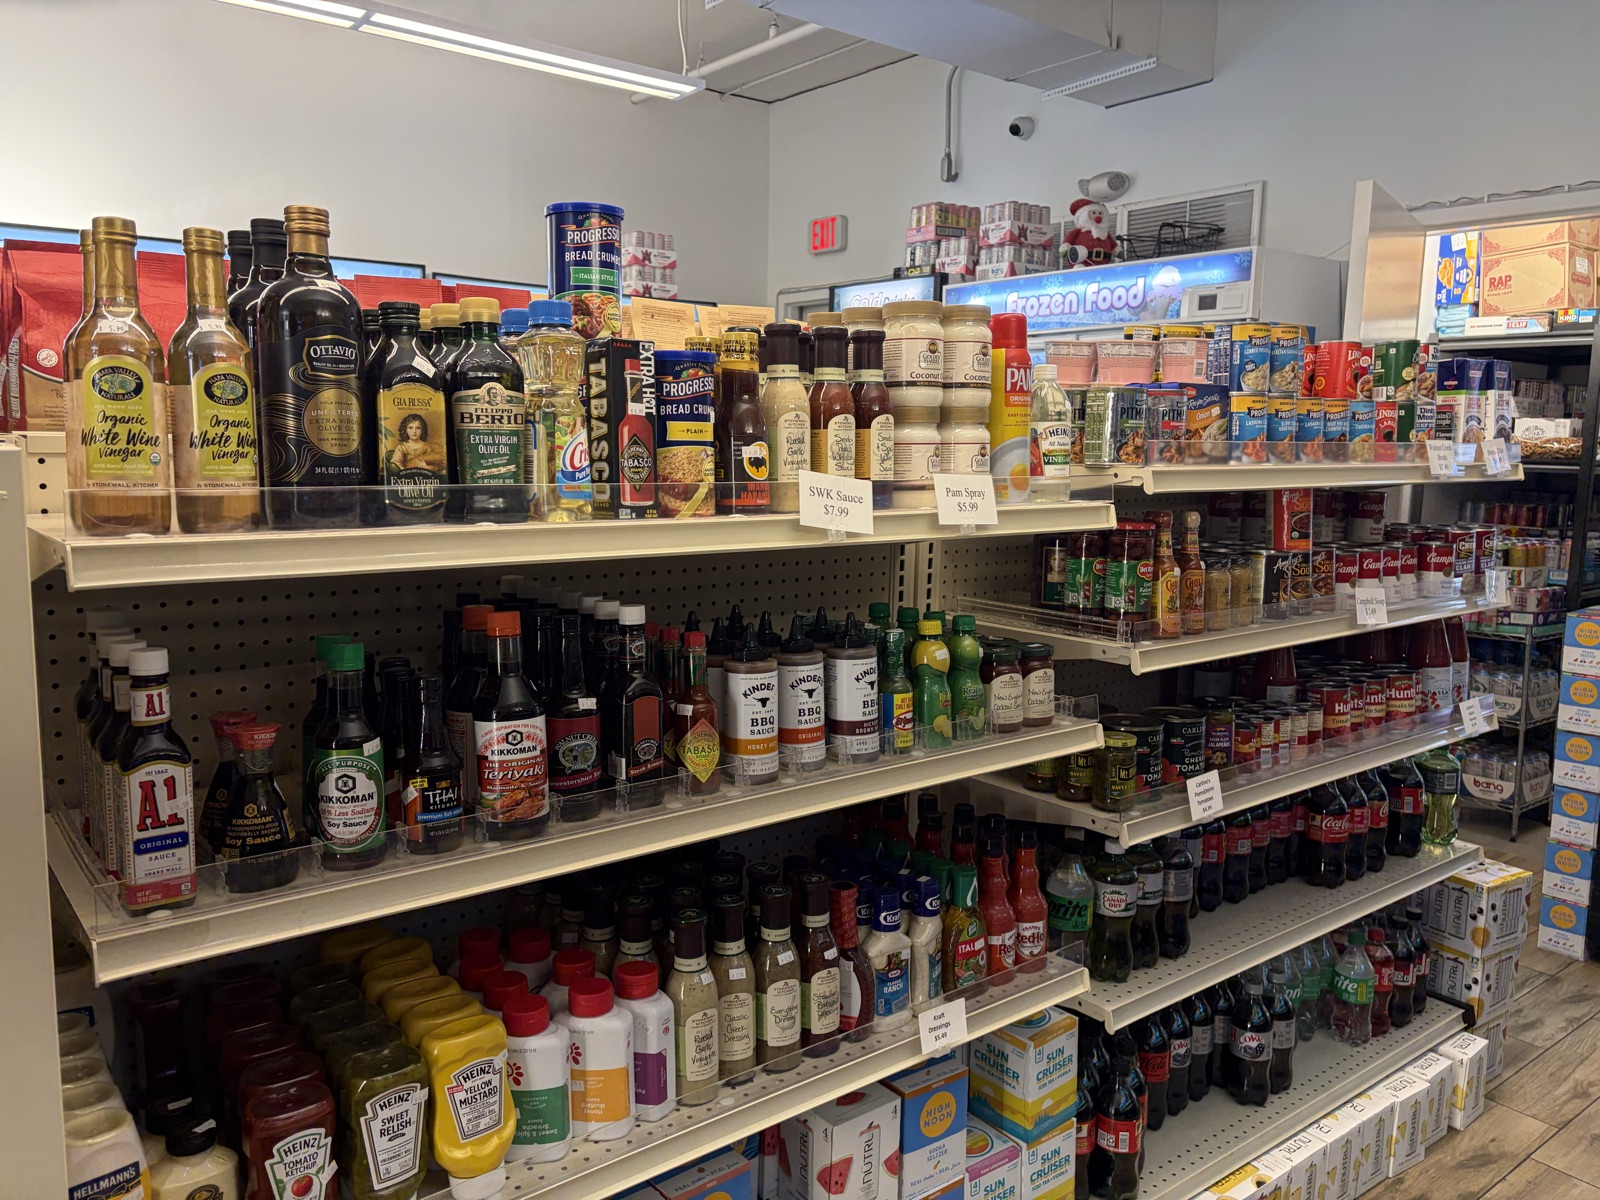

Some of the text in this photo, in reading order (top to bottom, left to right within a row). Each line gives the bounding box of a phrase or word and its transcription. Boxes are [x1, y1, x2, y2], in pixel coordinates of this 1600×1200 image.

[568, 228, 620, 243] PROGRESSO
[812, 218, 837, 250] EXIT
[565, 251, 593, 262] BREAD
[601, 274, 614, 282] STYLE
[1489, 274, 1512, 289] RAP
[1006, 276, 1146, 318] Frozen Food
[1560, 314, 1578, 322] KIND
[310, 345, 356, 360] OTTAVIO
[640, 342, 656, 416] EXTRA HOT
[910, 371, 938, 380] Coconut
[964, 373, 990, 382] Coconut
[662, 378, 714, 396] PROGRESSO
[100, 392, 136, 400] NATURALS
[393, 397, 430, 407] GIA RUSSA
[660, 404, 690, 416] BREAD
[1196, 412, 1210, 420] Onion
[97, 410, 148, 428] Organic
[210, 414, 251, 433] Organic
[309, 418, 336, 426] EXTRA
[460, 412, 524, 425] BERIO
[589, 357, 610, 500] TABASCO
[1049, 428, 1070, 438] HEINZ
[81, 427, 160, 448] White Wine
[190, 430, 234, 449] White
[470, 434, 518, 444] EXTRA VIRGIN
[99, 447, 145, 462] Vinegar
[478, 445, 510, 454] OLIVE OIL
[212, 450, 250, 464] Vinegar
[620, 458, 652, 466] TABASCO
[391, 478, 440, 489] Extra Virgin
[809, 486, 864, 504] SWK Sauce
[946, 488, 986, 500] Pam Spray
[824, 504, 849, 517] $7.99
[958, 502, 978, 512] $5.99
[1028, 698, 1046, 706] Cocktail
[798, 706, 822, 718] BBQ
[750, 716, 775, 728] BBQ
[798, 716, 822, 726] SAUCE
[750, 726, 776, 736] SAUCE
[798, 732, 822, 740] ORIGINAL
[856, 726, 874, 734] BROWN
[490, 744, 537, 757] KIKKOMAN
[503, 756, 543, 767] ORIGINAL
[484, 764, 544, 781] Teriyaki
[630, 766, 646, 776] Steak
[1196, 778, 1211, 788] Carlino's
[1474, 777, 1504, 794] bang
[320, 792, 374, 805] KIKKOMAN
[424, 787, 458, 804] THAI
[1197, 796, 1214, 806] Tomatoes
[334, 806, 376, 817] Less Sodium
[430, 801, 458, 810] KITCHEN
[232, 815, 272, 825] KIKKOMAN
[417, 812, 440, 821] premium
[327, 819, 368, 830] Soy Sauce
[140, 837, 184, 850] ORIGINAL
[225, 834, 282, 846] Soy Sauce
[148, 852, 177, 862] SAUCE
[1476, 886, 1484, 894] 12
[1108, 902, 1122, 910] DRY
[884, 982, 904, 994] RANCH
[770, 1003, 799, 1017] Everything
[724, 1013, 749, 1022] Classic
[934, 1012, 945, 1022] Kraft
[726, 1024, 748, 1034] Greek
[928, 1020, 951, 1034] Dressings
[724, 1032, 751, 1046] Dressing
[934, 1032, 948, 1042] $5.49
[986, 1043, 1008, 1063] SUN
[1046, 1046, 1065, 1064] SUN
[974, 1049, 1020, 1083] CRUISER
[1036, 1054, 1074, 1083] CRUISER
[462, 1065, 492, 1084] HEINZ
[1056, 1068, 1072, 1082] VODKA
[464, 1078, 492, 1096] YELLOW
[998, 1074, 1016, 1090] VODKA
[378, 1092, 412, 1112] HEINZ
[459, 1084, 498, 1108] MUSTARD
[926, 1102, 951, 1116] HIGH
[381, 1110, 410, 1127] SWEET
[924, 1112, 952, 1129] NOON
[380, 1118, 412, 1138] RELISH
[539, 1128, 558, 1136] Sweet
[282, 1137, 318, 1158] HEINZ
[928, 1144, 946, 1154] VODKA
[282, 1152, 319, 1171] TOMATO
[926, 1148, 948, 1163] SELTZER
[1040, 1146, 1061, 1164] SUN
[285, 1161, 318, 1178] KETCHUP
[1030, 1154, 1070, 1184] CRUISER
[73, 1166, 136, 1200] HELLMANN'S
[674, 1166, 725, 1194] REAL REAL
[984, 1178, 1006, 1196] SUN
